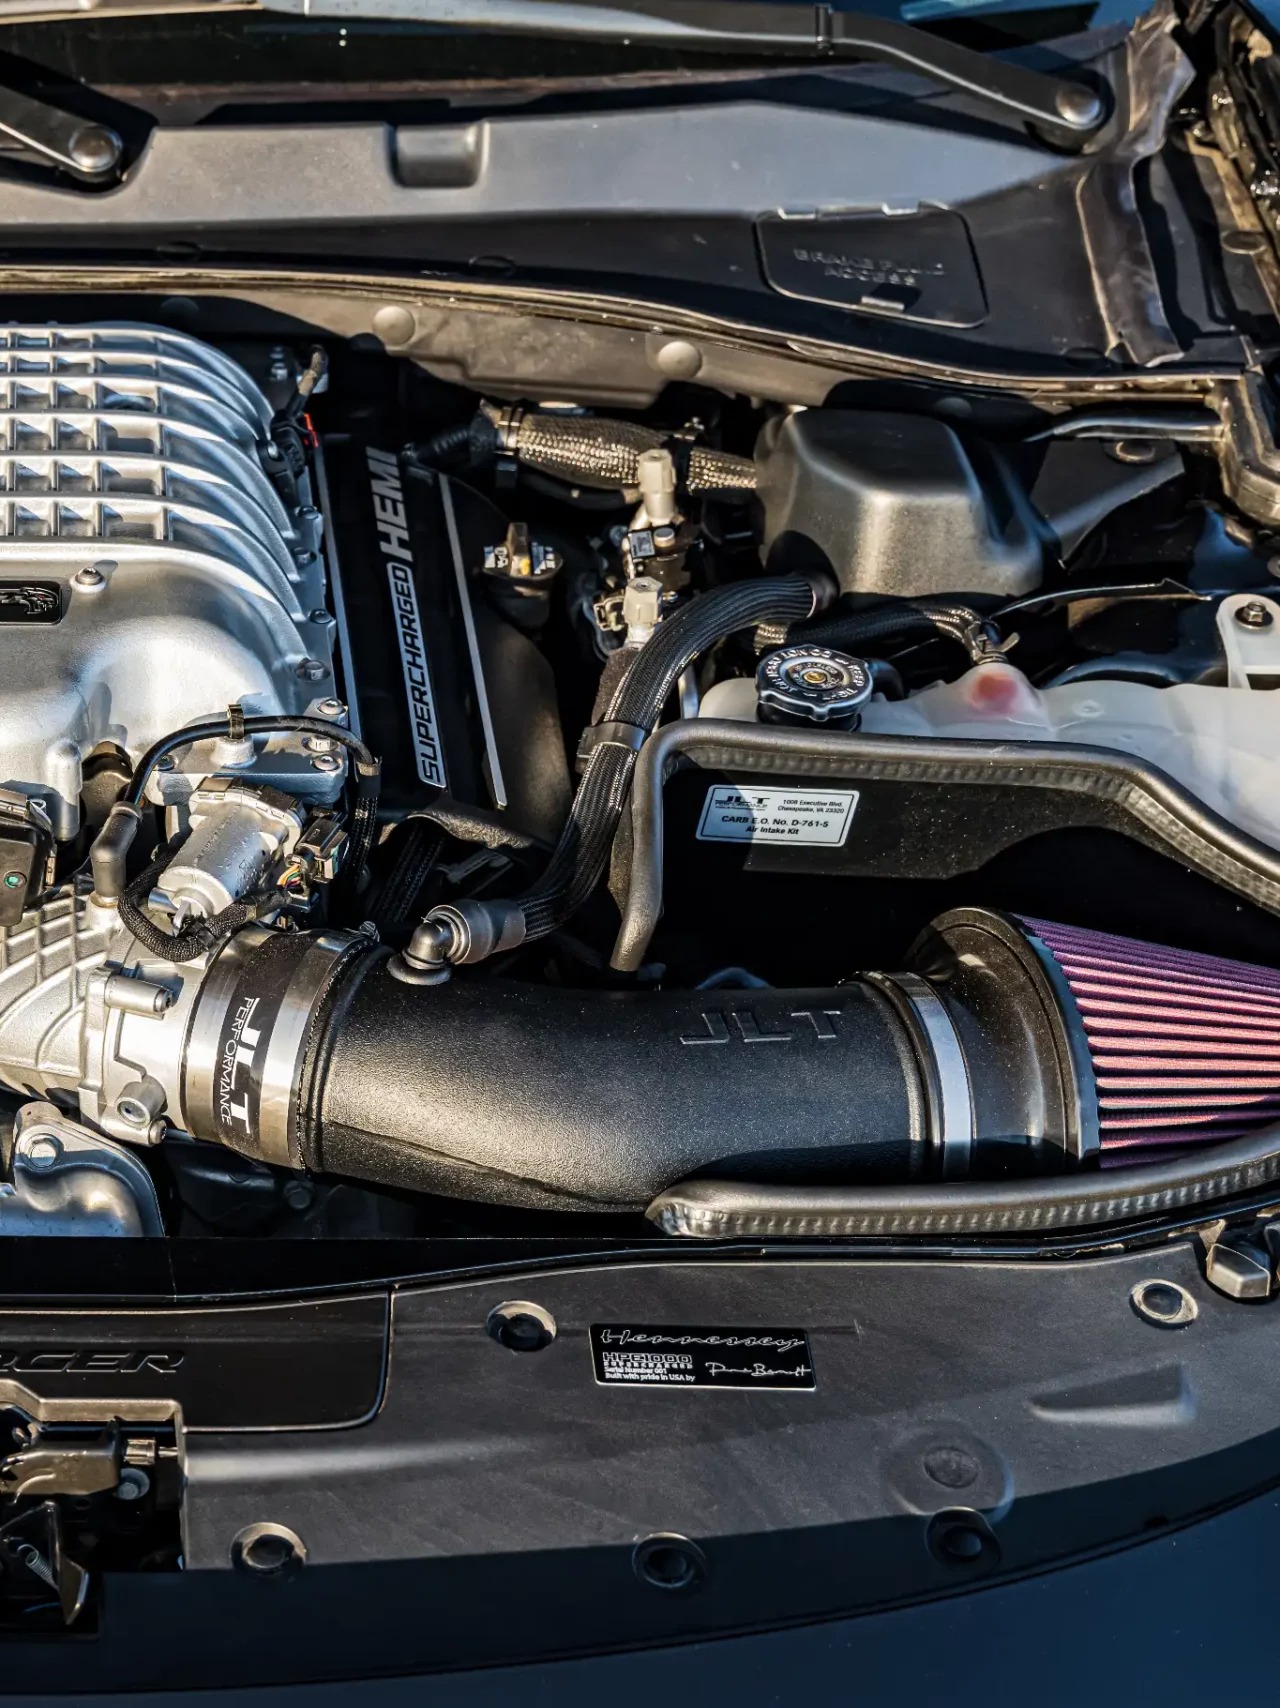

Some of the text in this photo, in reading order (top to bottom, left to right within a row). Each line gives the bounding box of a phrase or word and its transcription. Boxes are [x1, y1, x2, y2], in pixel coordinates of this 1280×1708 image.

[366, 446, 441, 784] SUPERCHARGED HEMI
[721, 815, 749, 824] CARB
[751, 817, 770, 825] E.O.
[791, 819, 829, 828] D-761-5
[680, 1010, 842, 1045] JLT
[220, 997, 254, 1127] PERFORMANCE
[231, 998, 262, 1134] JLT
[601, 1329, 805, 1352] Hennessey
[602, 1352, 693, 1364] HPE1000
[603, 1361, 694, 1369] SUPERCHARGED
[640, 1373, 660, 1381] pride
[685, 1374, 696, 1382] by
